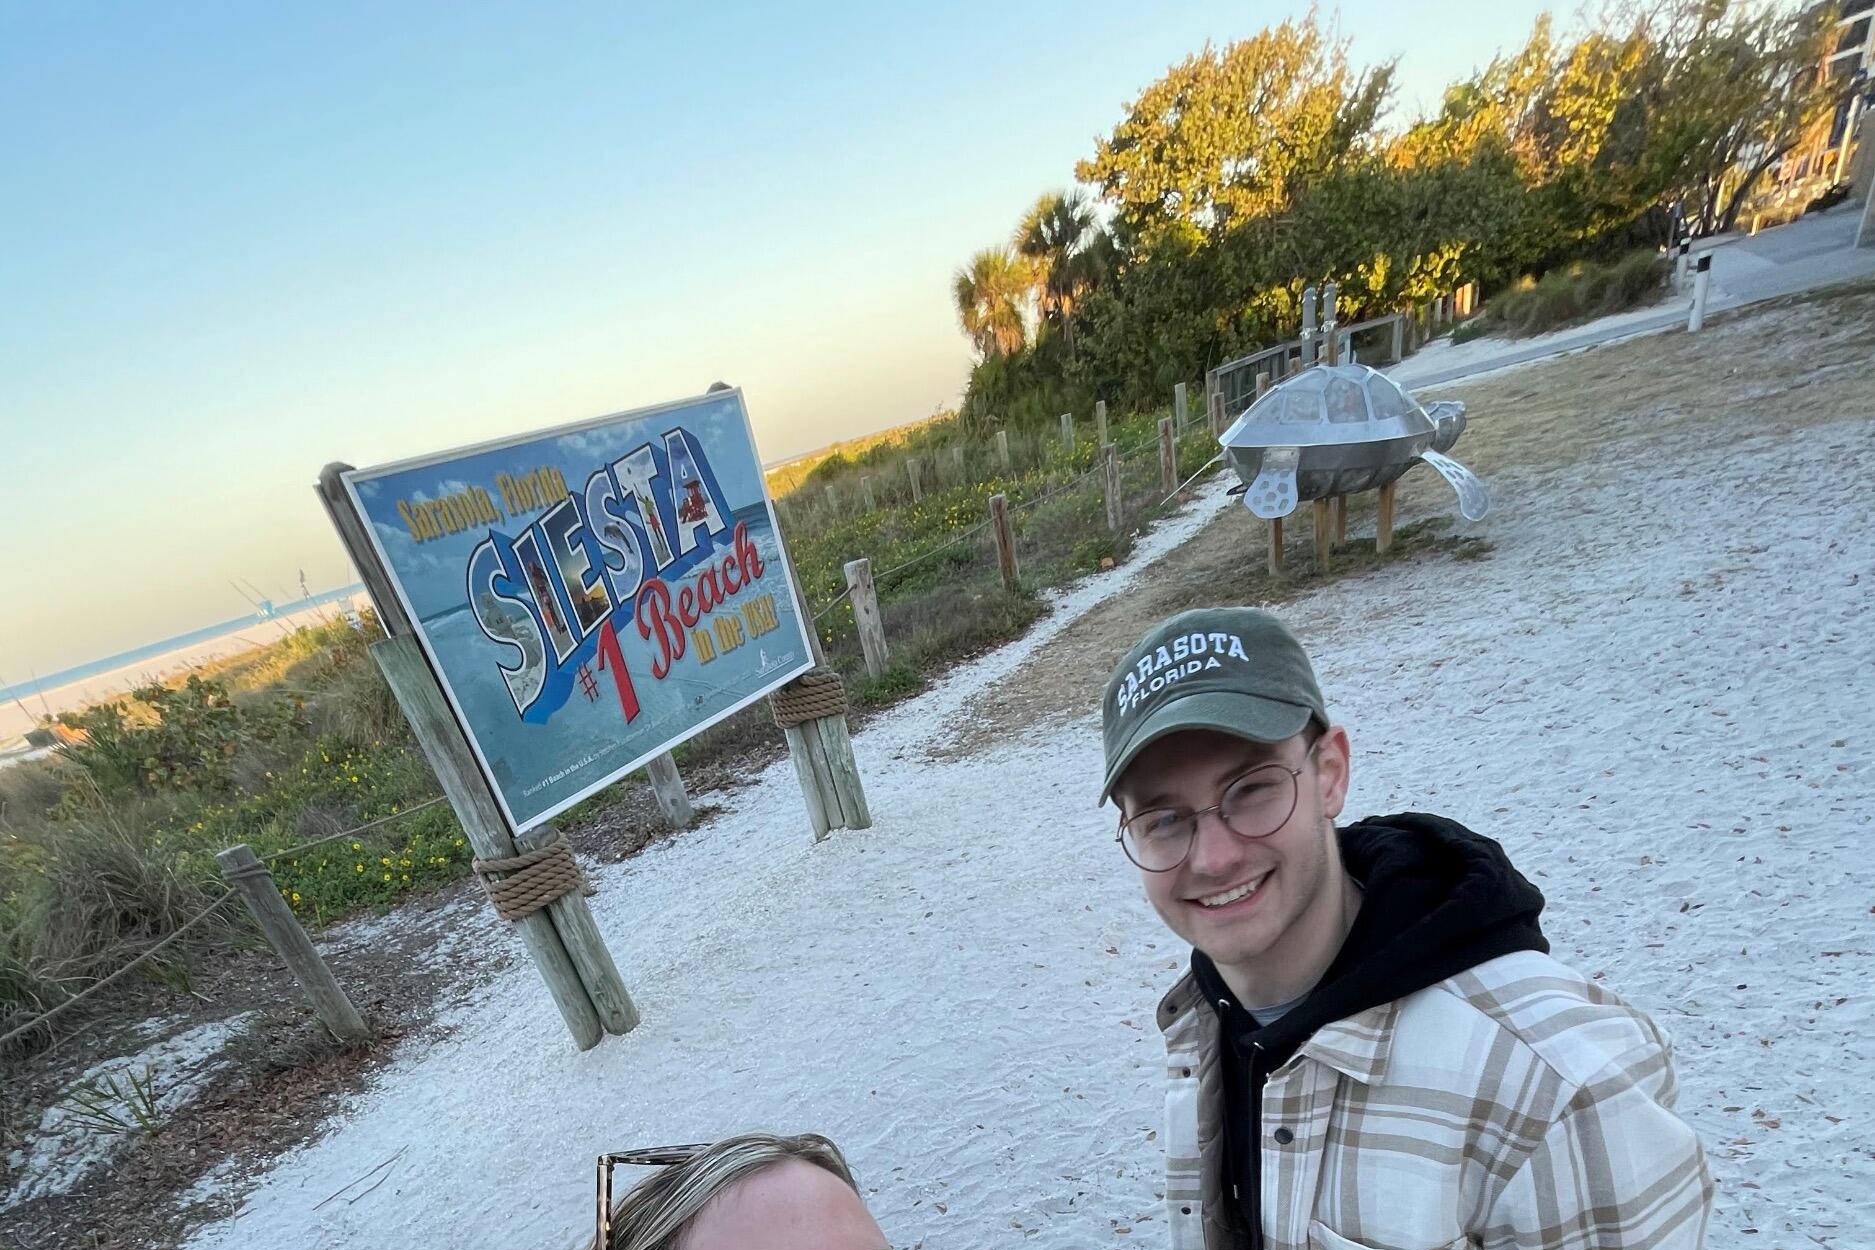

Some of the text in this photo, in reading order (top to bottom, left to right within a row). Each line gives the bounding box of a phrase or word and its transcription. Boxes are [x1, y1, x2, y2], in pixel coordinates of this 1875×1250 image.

[397, 464, 569, 544] Sarasota, Florida
[466, 426, 731, 723] SIESTA
[634, 520, 765, 680] Beach
[690, 629, 717, 666] in
[713, 615, 745, 655] the
[1117, 632, 1250, 717] SARASOTA
[1131, 656, 1222, 709] FLORIDA
